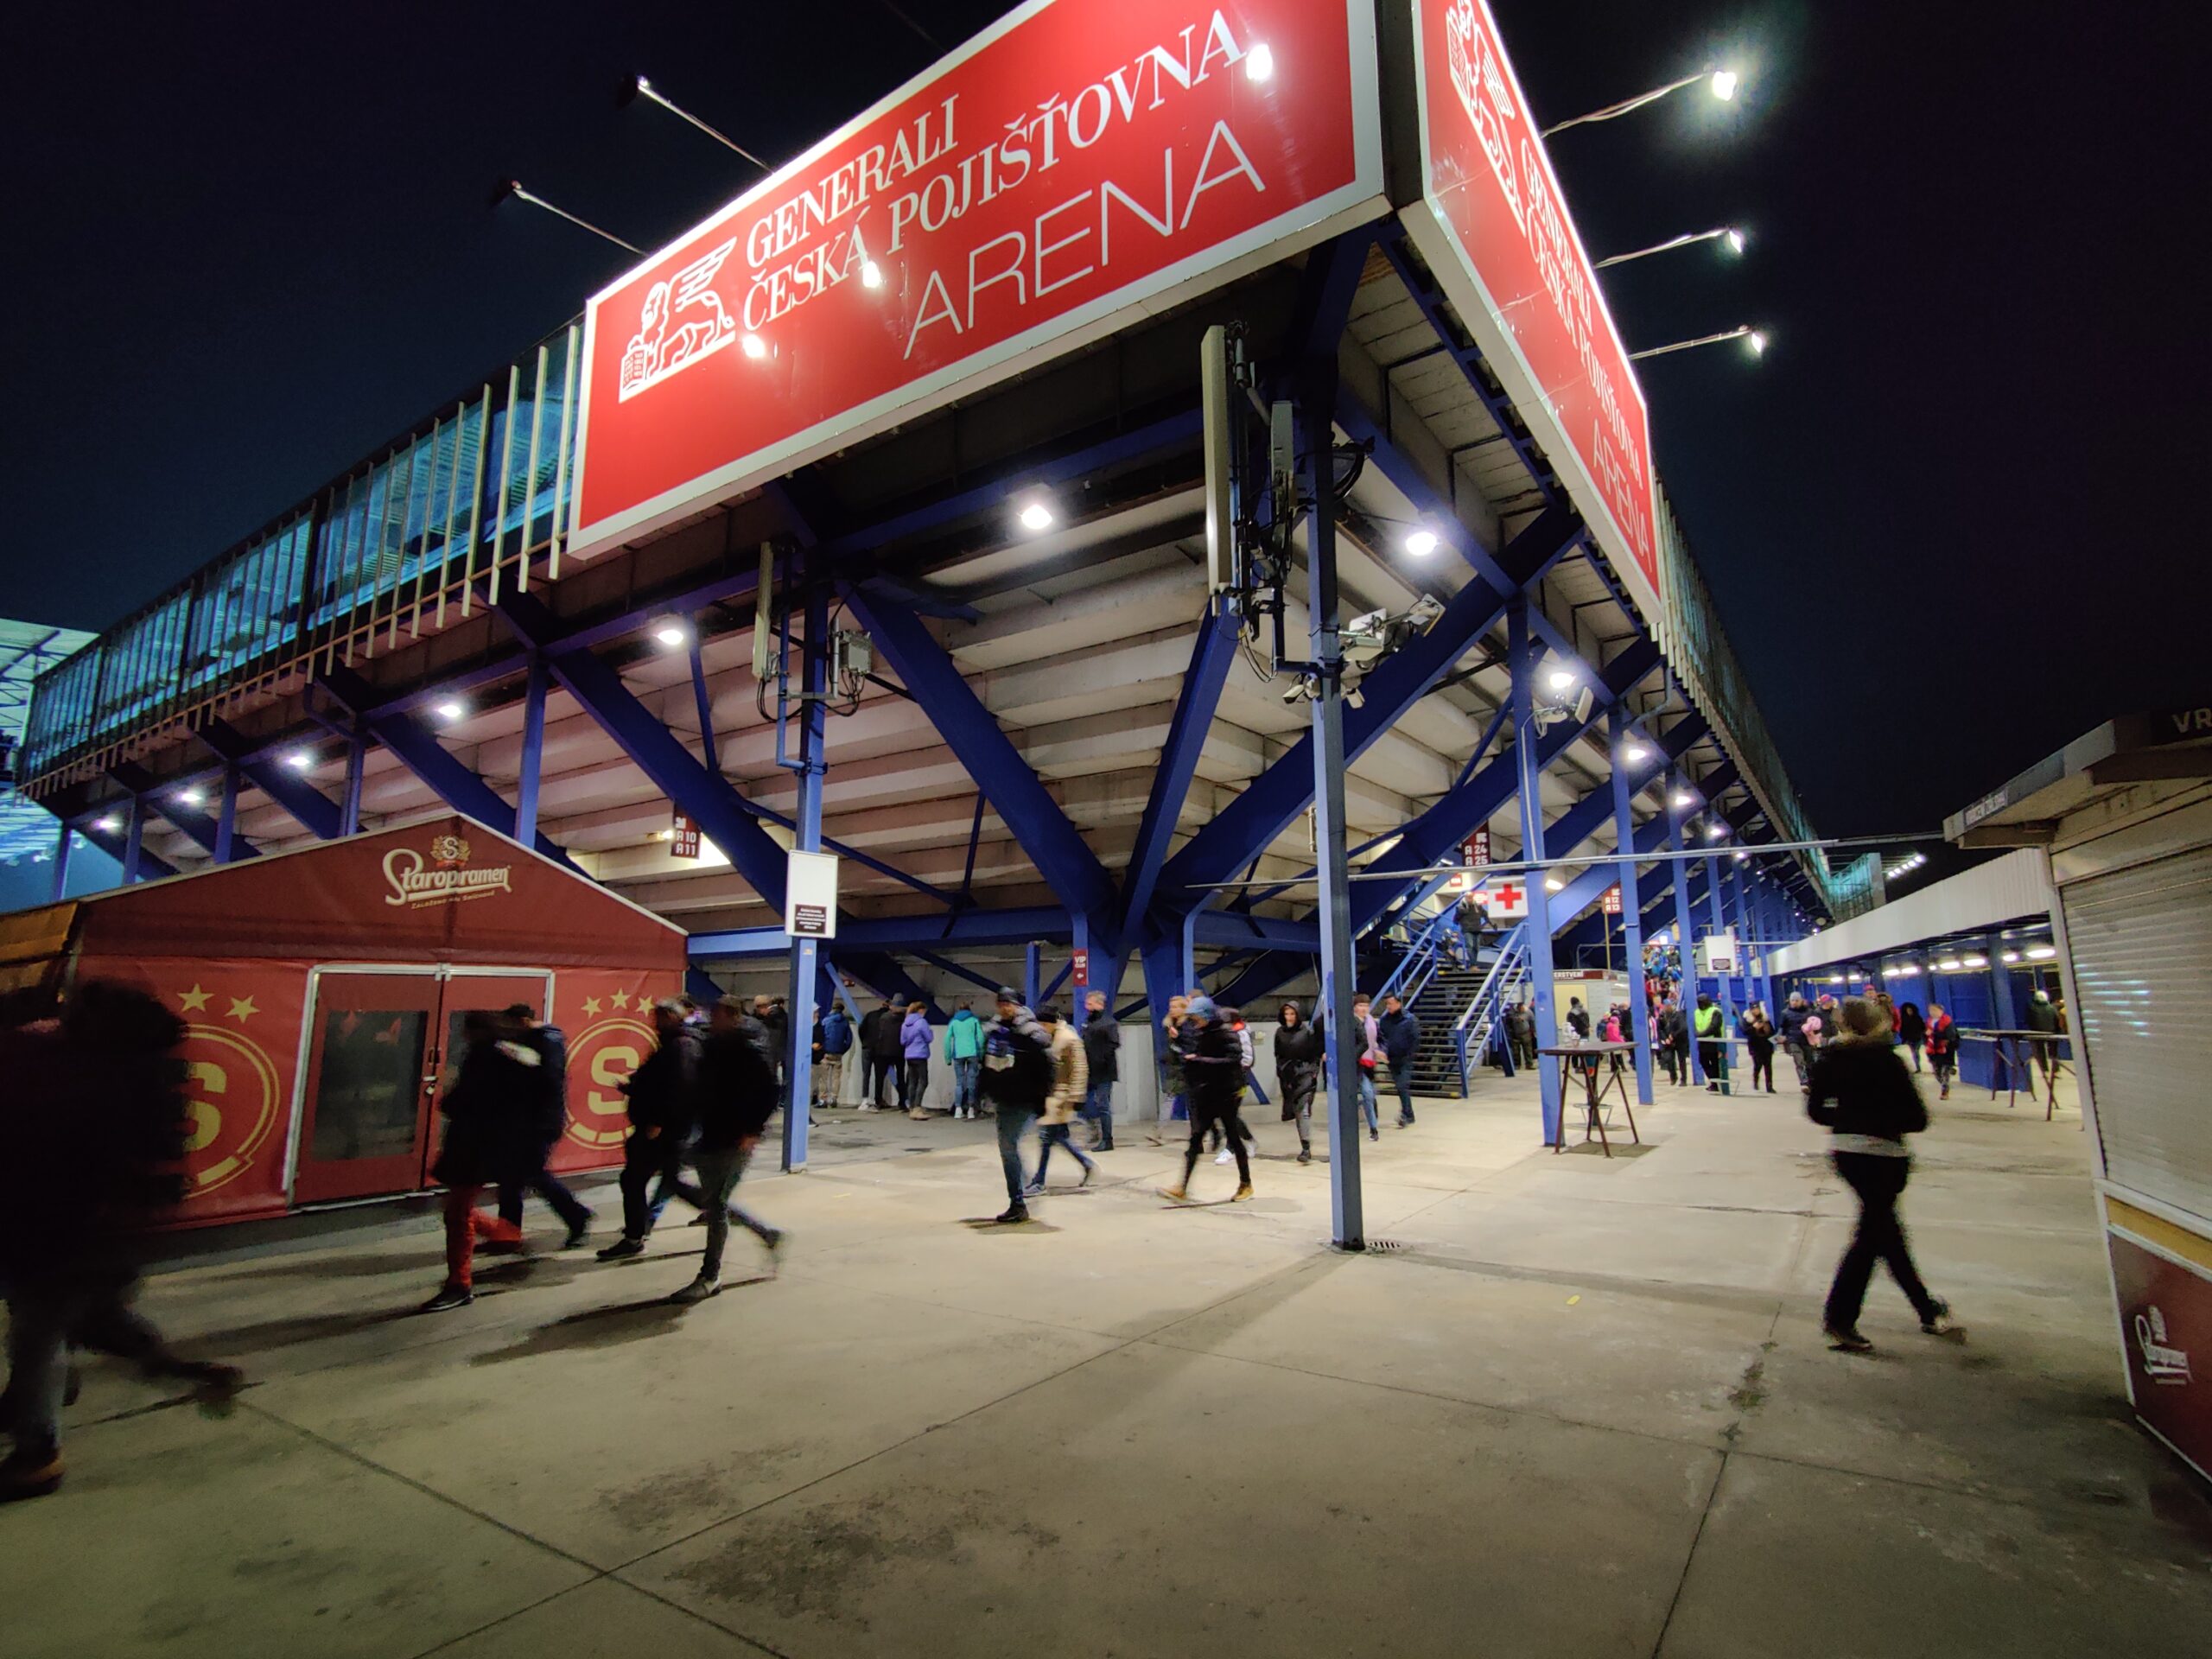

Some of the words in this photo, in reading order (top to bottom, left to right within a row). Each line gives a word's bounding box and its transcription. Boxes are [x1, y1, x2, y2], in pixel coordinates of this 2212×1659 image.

[743, 205, 871, 331] ČESKÁ
[887, 9, 1247, 256] POJIŠŤOVNA
[747, 93, 959, 268] GENERALI
[903, 119, 1266, 360] ARENA
[1521, 138, 1593, 336] GENERALI
[1593, 418, 1652, 573] ARENA
[382, 848, 512, 906] Staropramen
[588, 1046, 639, 1116] S
